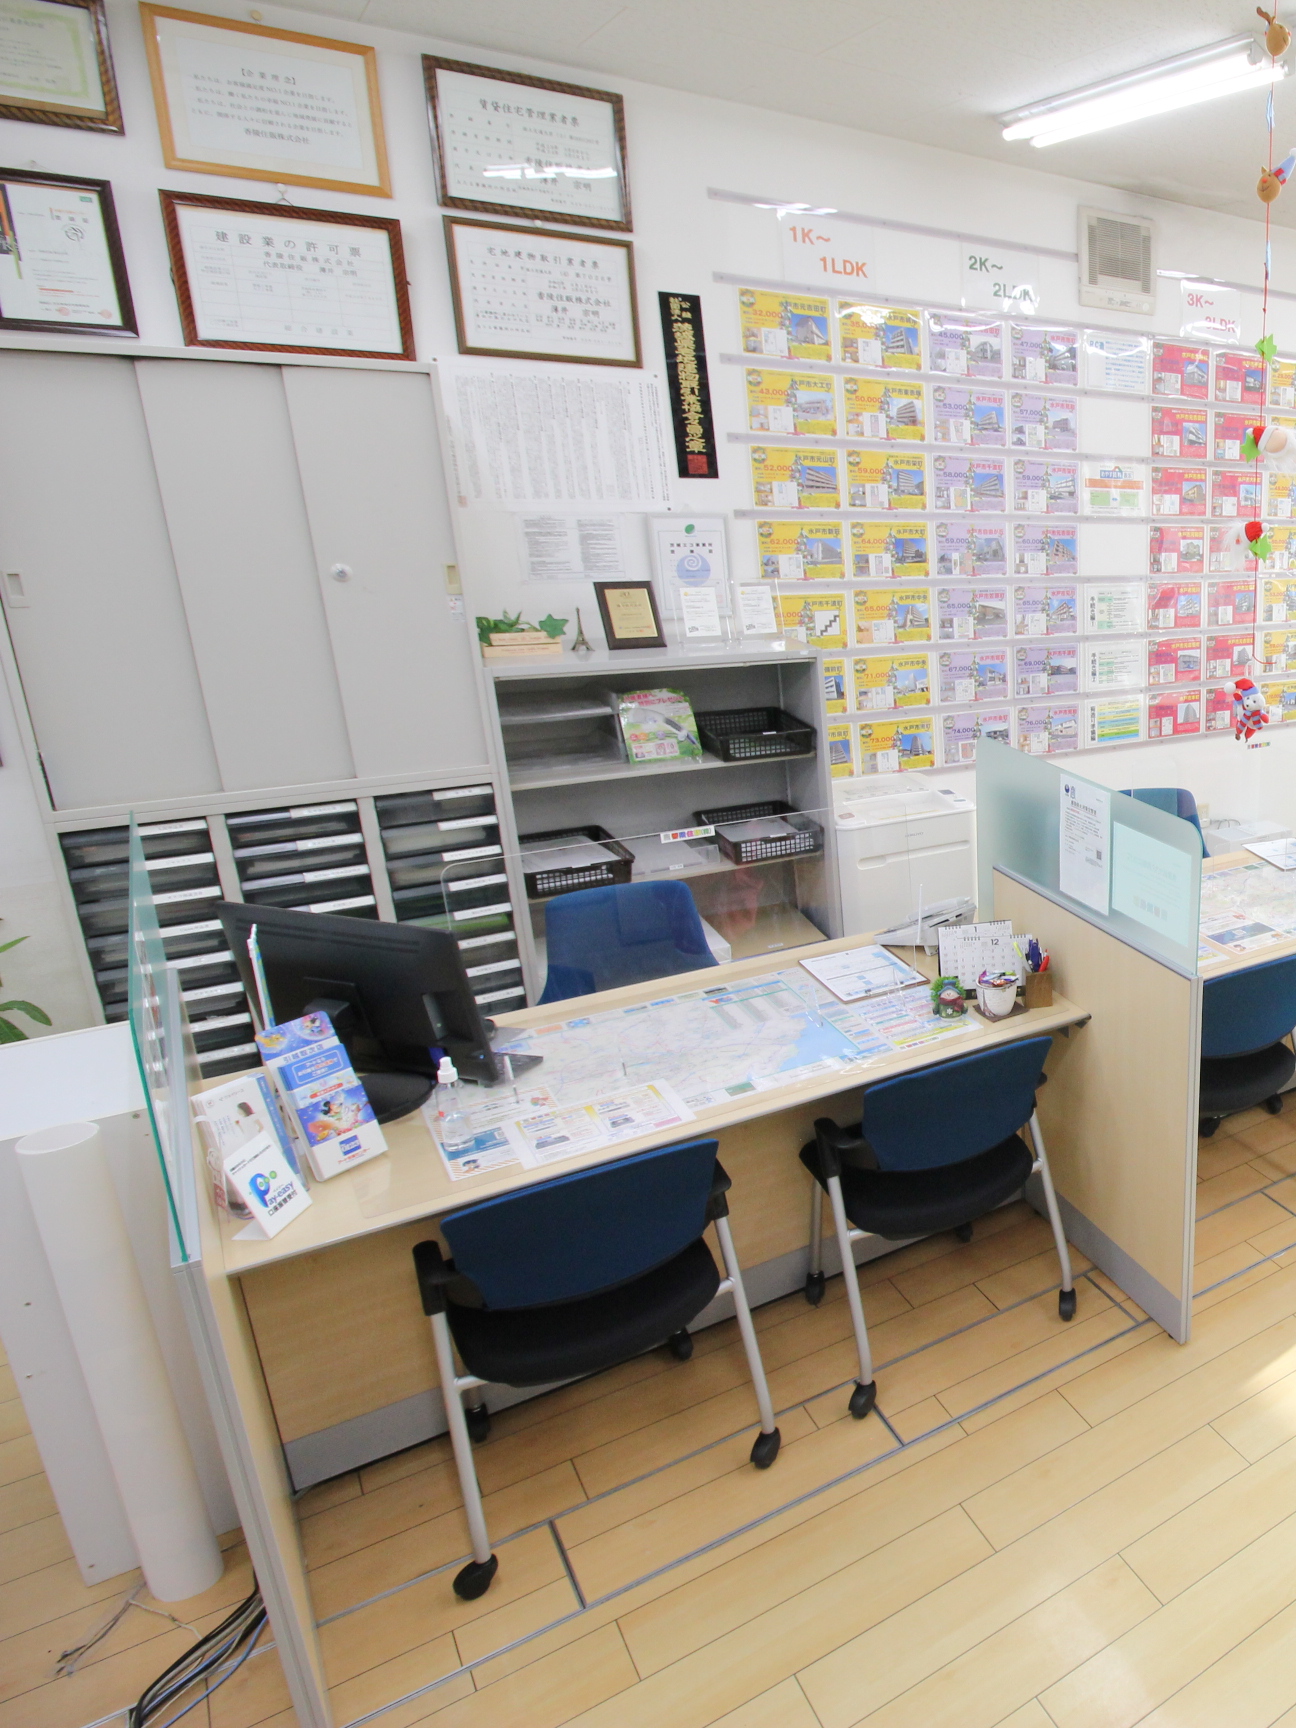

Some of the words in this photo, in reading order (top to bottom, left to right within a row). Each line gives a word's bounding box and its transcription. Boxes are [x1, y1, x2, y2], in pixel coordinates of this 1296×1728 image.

[479, 98, 580, 128] 賃貸住宅管理業者票
[215, 230, 362, 258] 建設業の許可票
[263, 251, 355, 268] 香陵住販株式会社
[263, 260, 304, 272] 代表取締役
[486, 246, 600, 270] 宅地建物取引業者票
[819, 256, 869, 278] 1LDK
[537, 291, 612, 308] 香陵住販株式会社
[990, 938, 1000, 946] 12
